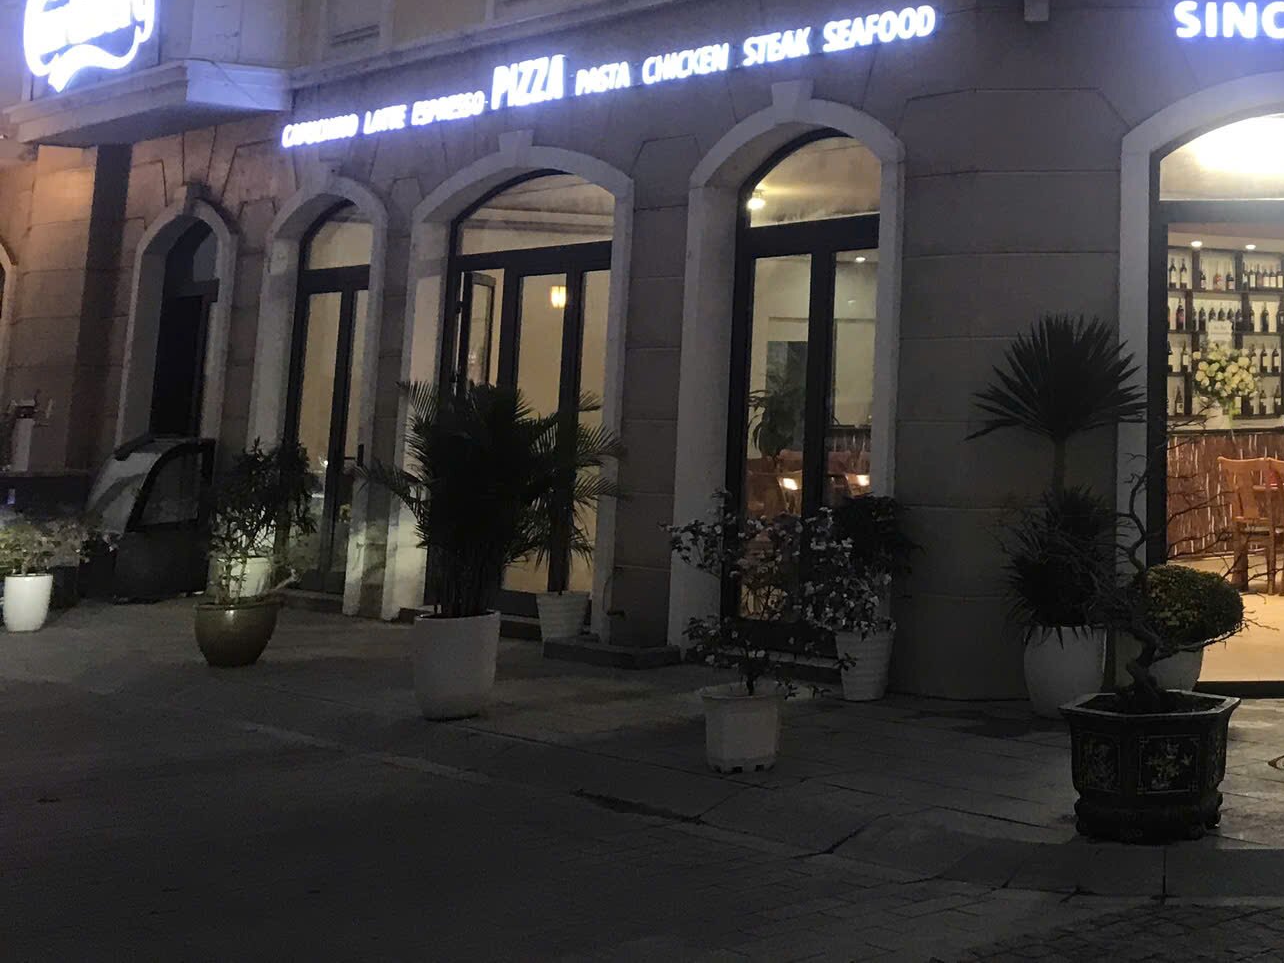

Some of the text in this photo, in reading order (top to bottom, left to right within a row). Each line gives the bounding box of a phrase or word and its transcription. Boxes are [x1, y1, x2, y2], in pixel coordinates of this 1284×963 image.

[491, 54, 565, 110] PIZZA
[575, 61, 631, 96] PASTA
[642, 42, 730, 85] CHICKEN
[742, 26, 811, 66] STEAK
[822, 5, 936, 52] SEAFOOD
